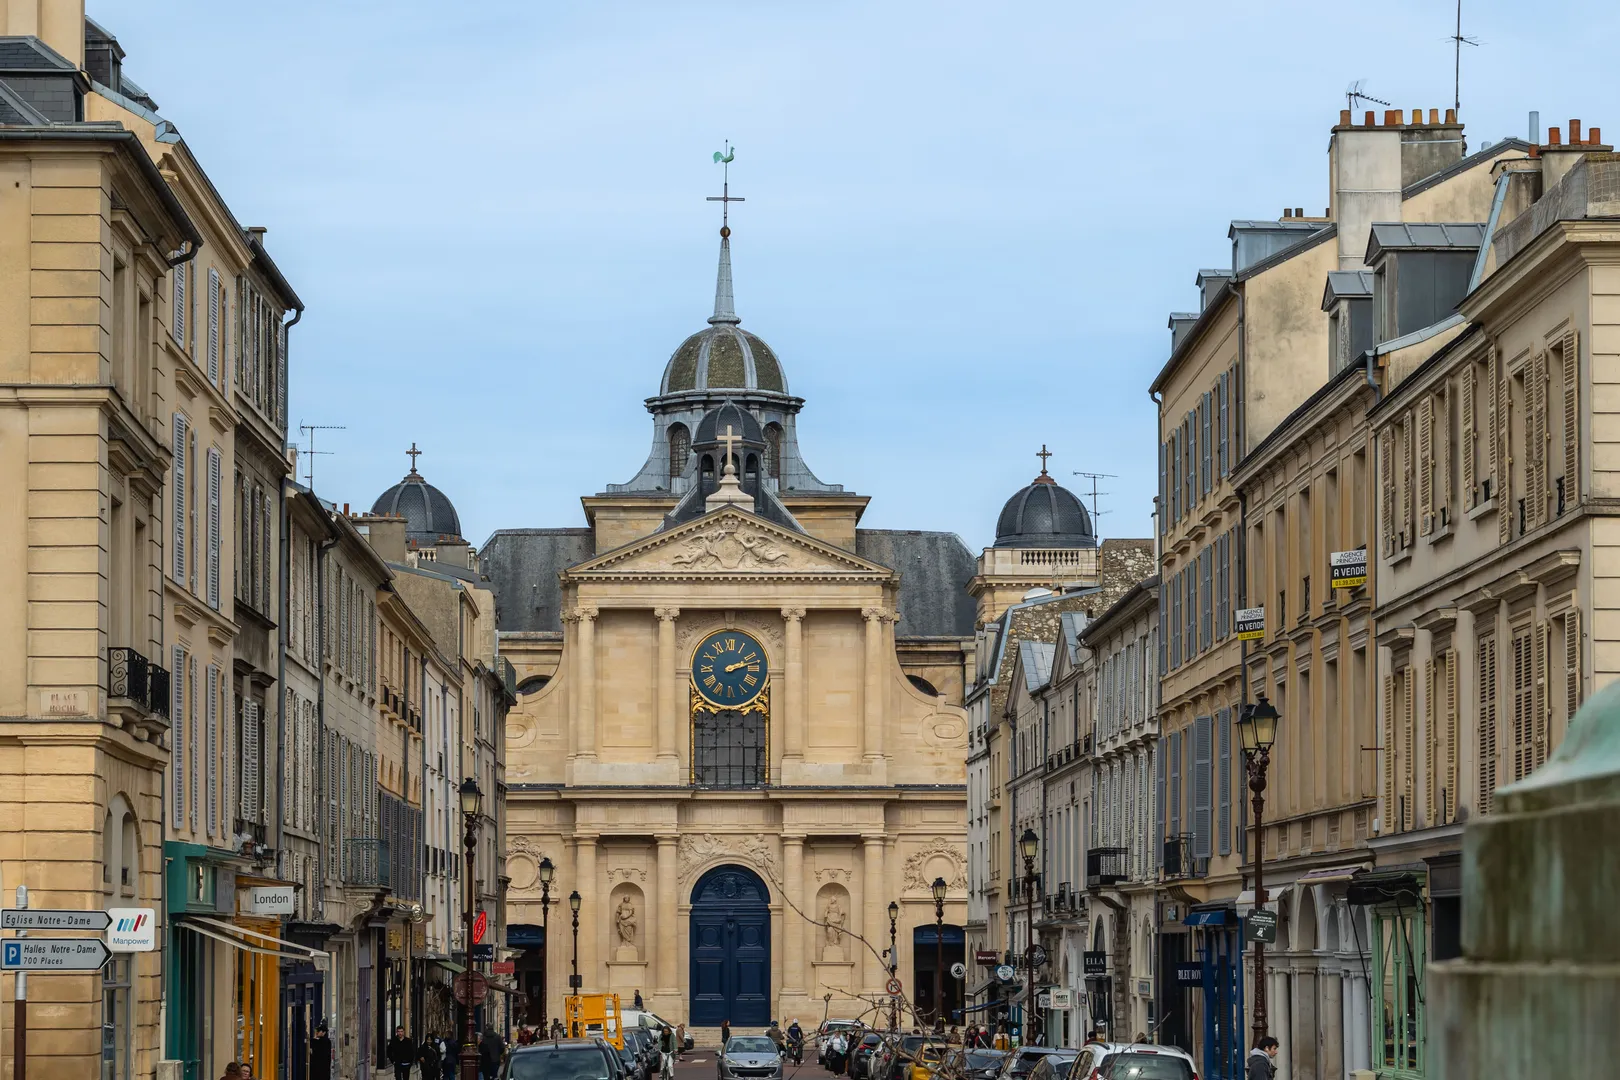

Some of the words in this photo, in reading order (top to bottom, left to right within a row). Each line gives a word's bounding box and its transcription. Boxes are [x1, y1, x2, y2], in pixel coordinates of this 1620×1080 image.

[1340, 551, 1363, 559] AGENCE
[1333, 568, 1339, 577] A
[1341, 566, 1366, 577] VENDR
[1239, 623, 1244, 631] A
[51, 693, 77, 701] PLACE
[254, 893, 289, 904] London
[37, 915, 91, 925] Notre-Dame
[112, 937, 149, 946] Manpower
[24, 944, 46, 953] Halles
[9, 946, 17, 962] P
[40, 957, 63, 965] Places
[1086, 957, 1104, 965] ELLA
